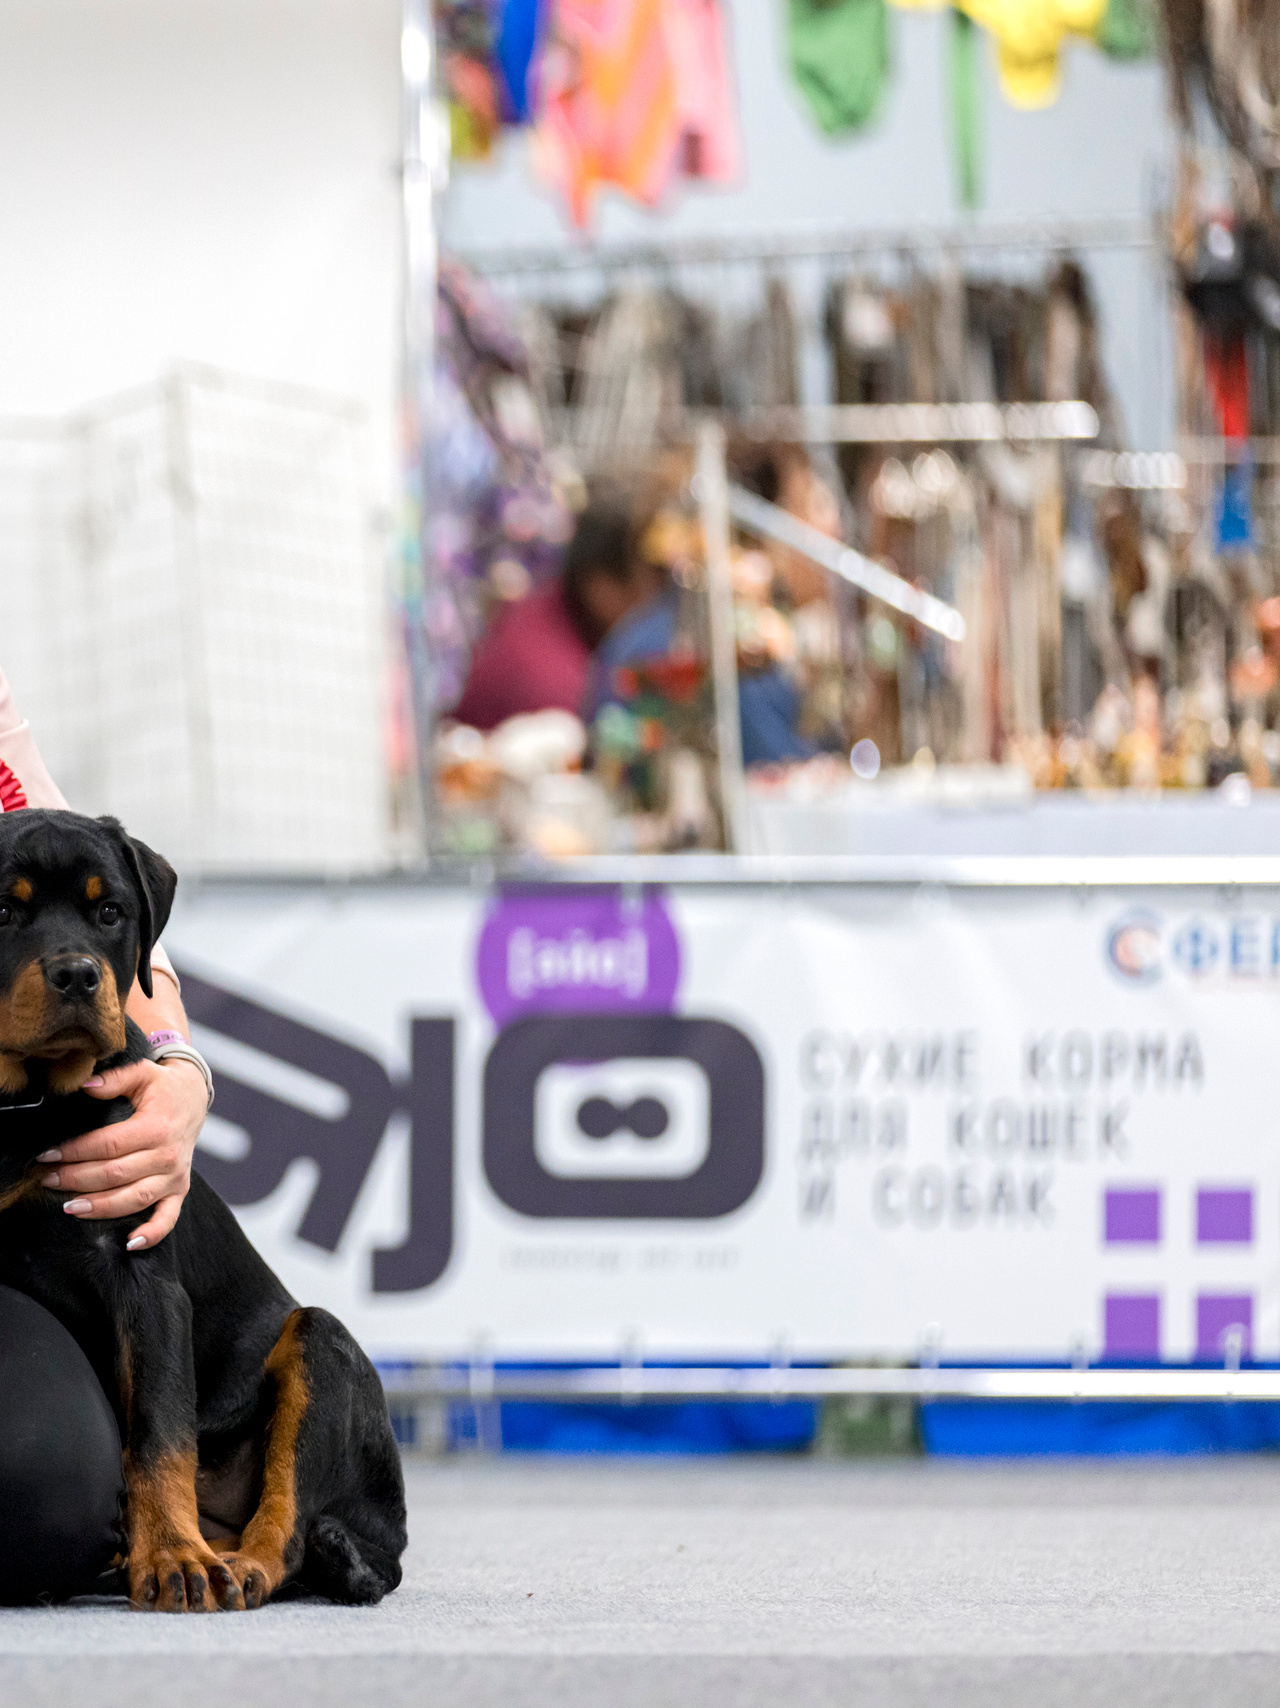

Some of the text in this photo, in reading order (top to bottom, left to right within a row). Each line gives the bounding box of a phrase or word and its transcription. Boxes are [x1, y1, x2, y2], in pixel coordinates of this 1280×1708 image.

[801, 1029, 1204, 1092] СУХИЕ КОРМА
[799, 1095, 1132, 1163] ДЛЯ КОШЕК
[799, 1164, 1054, 1229] И СОБАК
